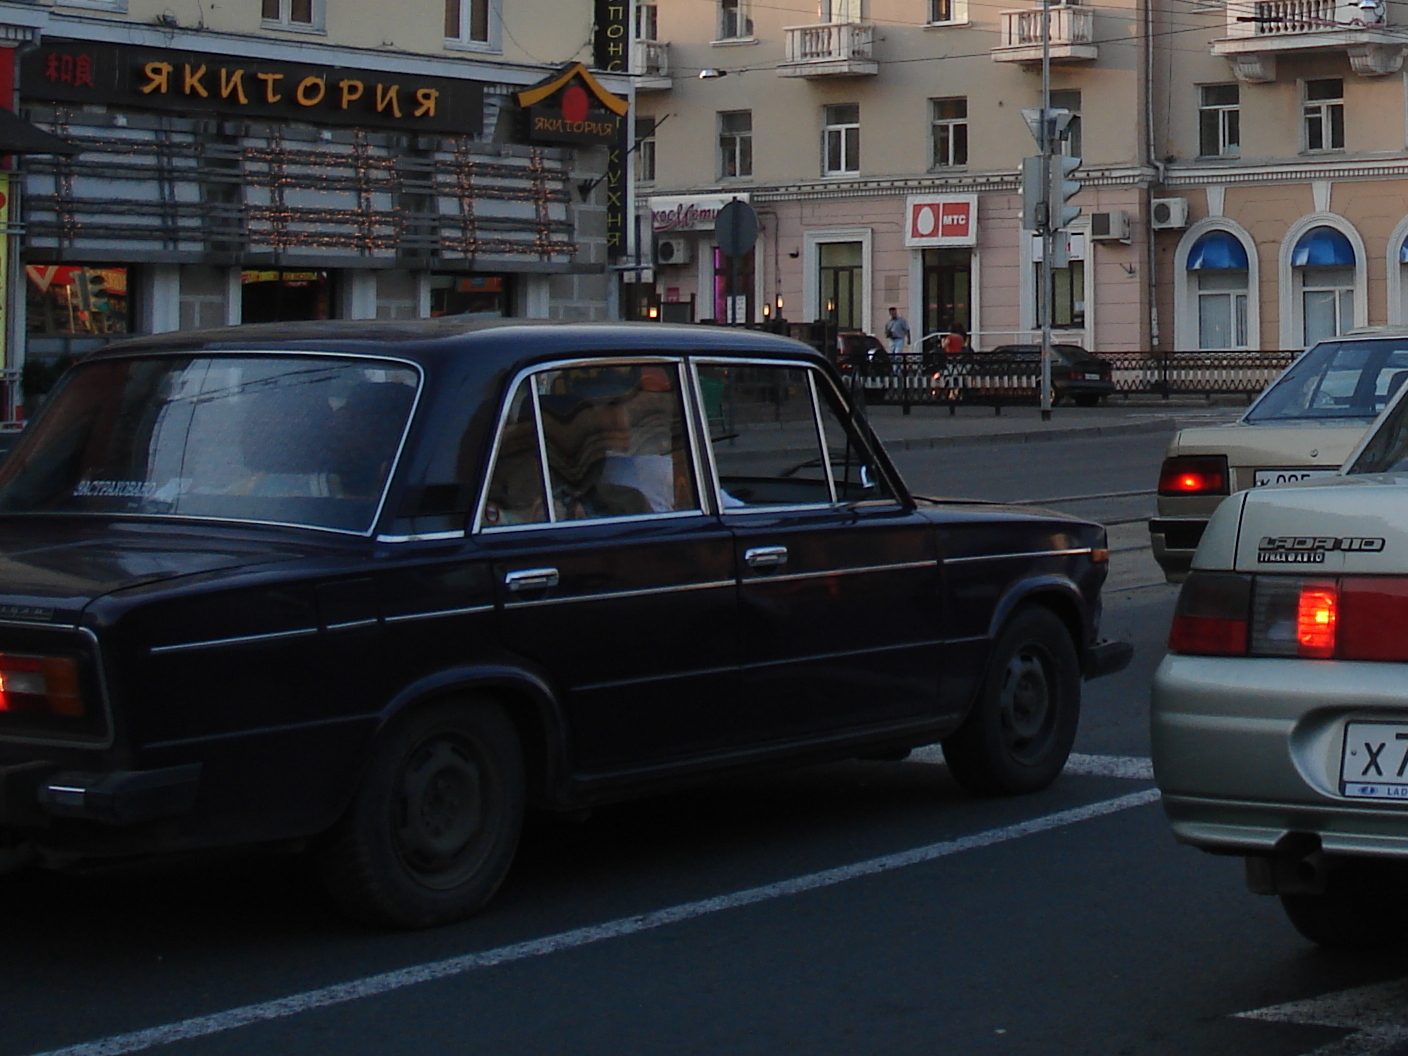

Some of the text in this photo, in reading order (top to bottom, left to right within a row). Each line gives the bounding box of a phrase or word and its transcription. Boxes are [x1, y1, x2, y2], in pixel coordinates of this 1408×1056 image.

[44, 52, 95, 88] 和食
[141, 60, 440, 119] ЯКИТОРИЯ
[534, 116, 613, 136] ЯКИТОРИЯ
[606, 145, 621, 248] КУХНЯ
[943, 214, 966, 225] МТС
[1259, 536, 1386, 552] LADA 110
